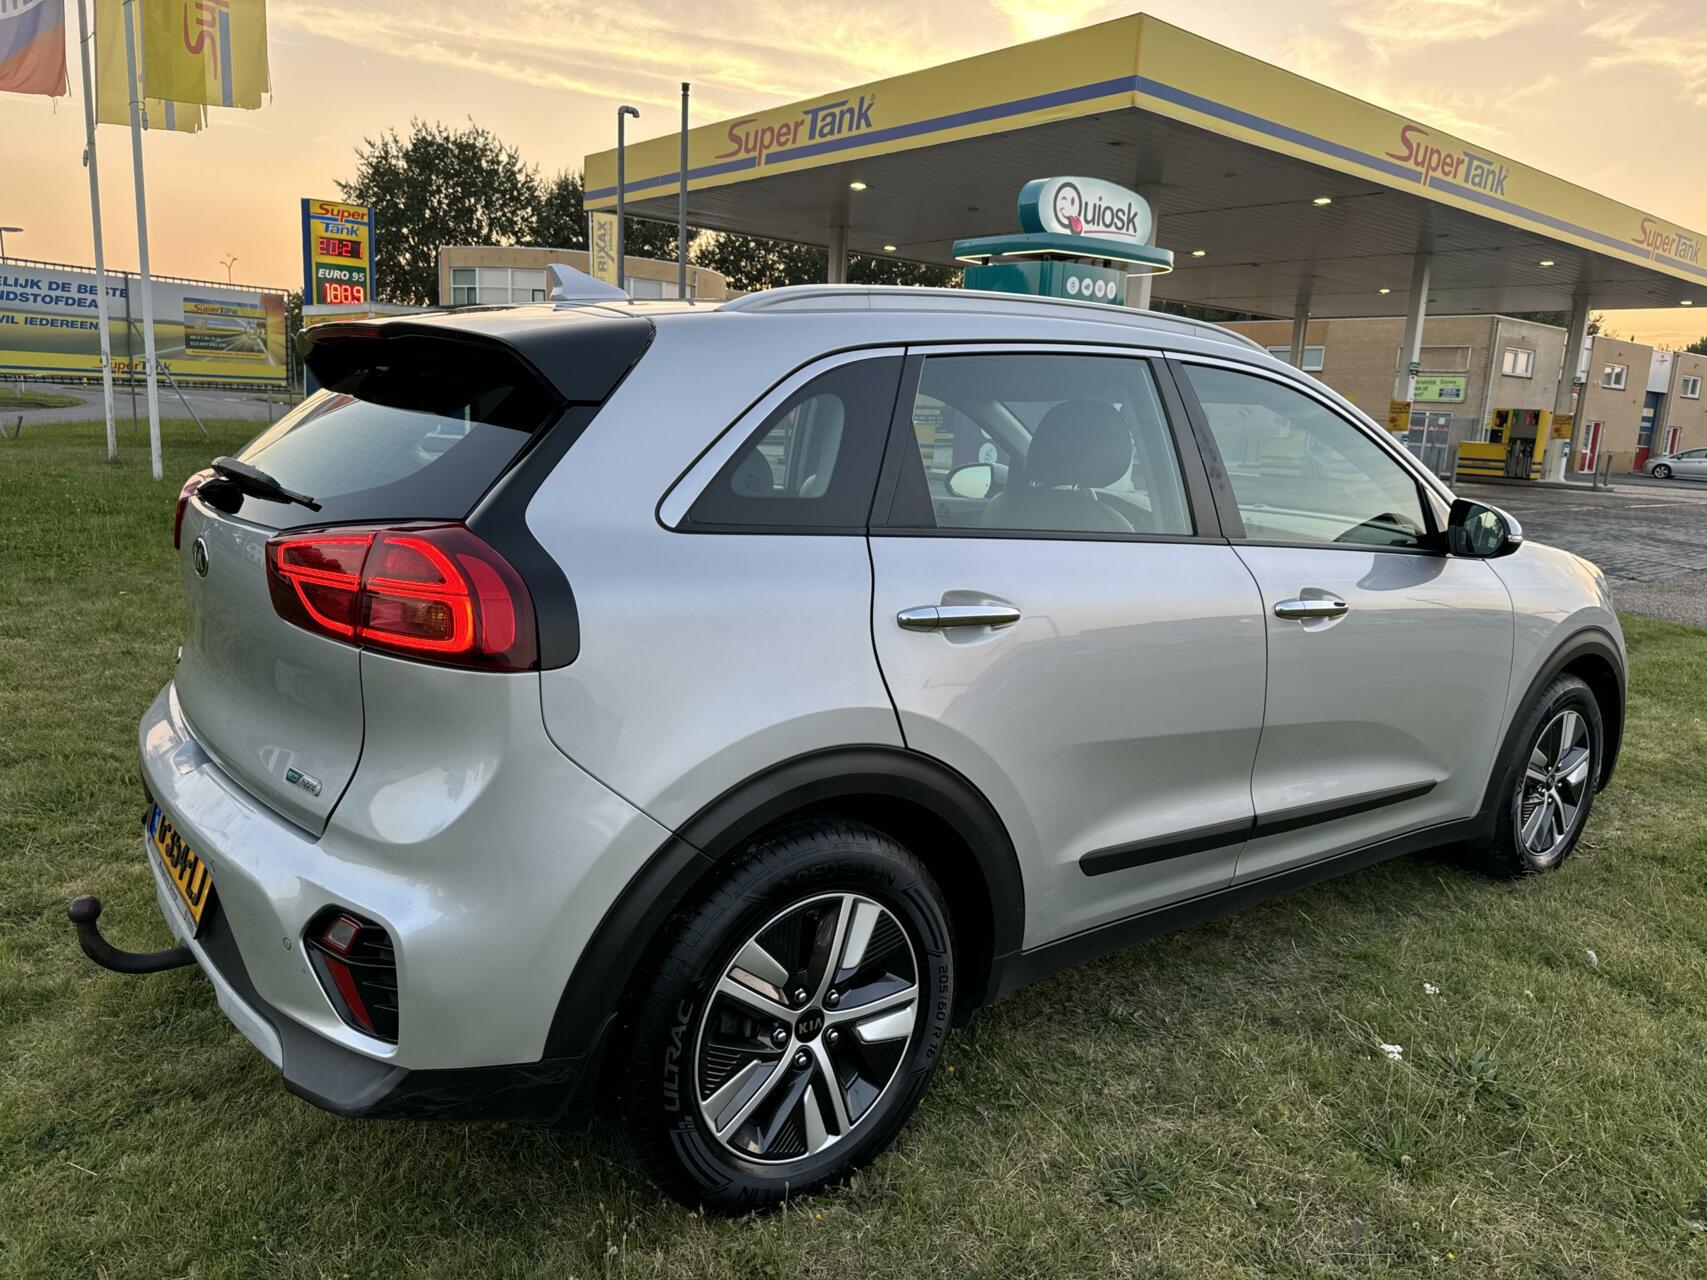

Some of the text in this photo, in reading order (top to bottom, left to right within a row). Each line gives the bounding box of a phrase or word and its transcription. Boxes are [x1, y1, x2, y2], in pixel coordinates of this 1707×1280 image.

[715, 95, 874, 167] SuperTank
[1385, 124, 1508, 196] SuperTank
[319, 203, 367, 222] Super
[1054, 182, 1138, 235] Quiosk
[321, 222, 359, 236] Tank
[1631, 217, 1701, 264] SuperTank
[0, 276, 42, 290] LIJK
[48, 281, 72, 292] DE
[318, 269, 365, 281] EURO 95
[936, 965, 949, 1021] 205/60
[799, 1017, 822, 1034] KIA
[932, 1025, 942, 1039] R
[663, 999, 694, 1111] ULTRAC
